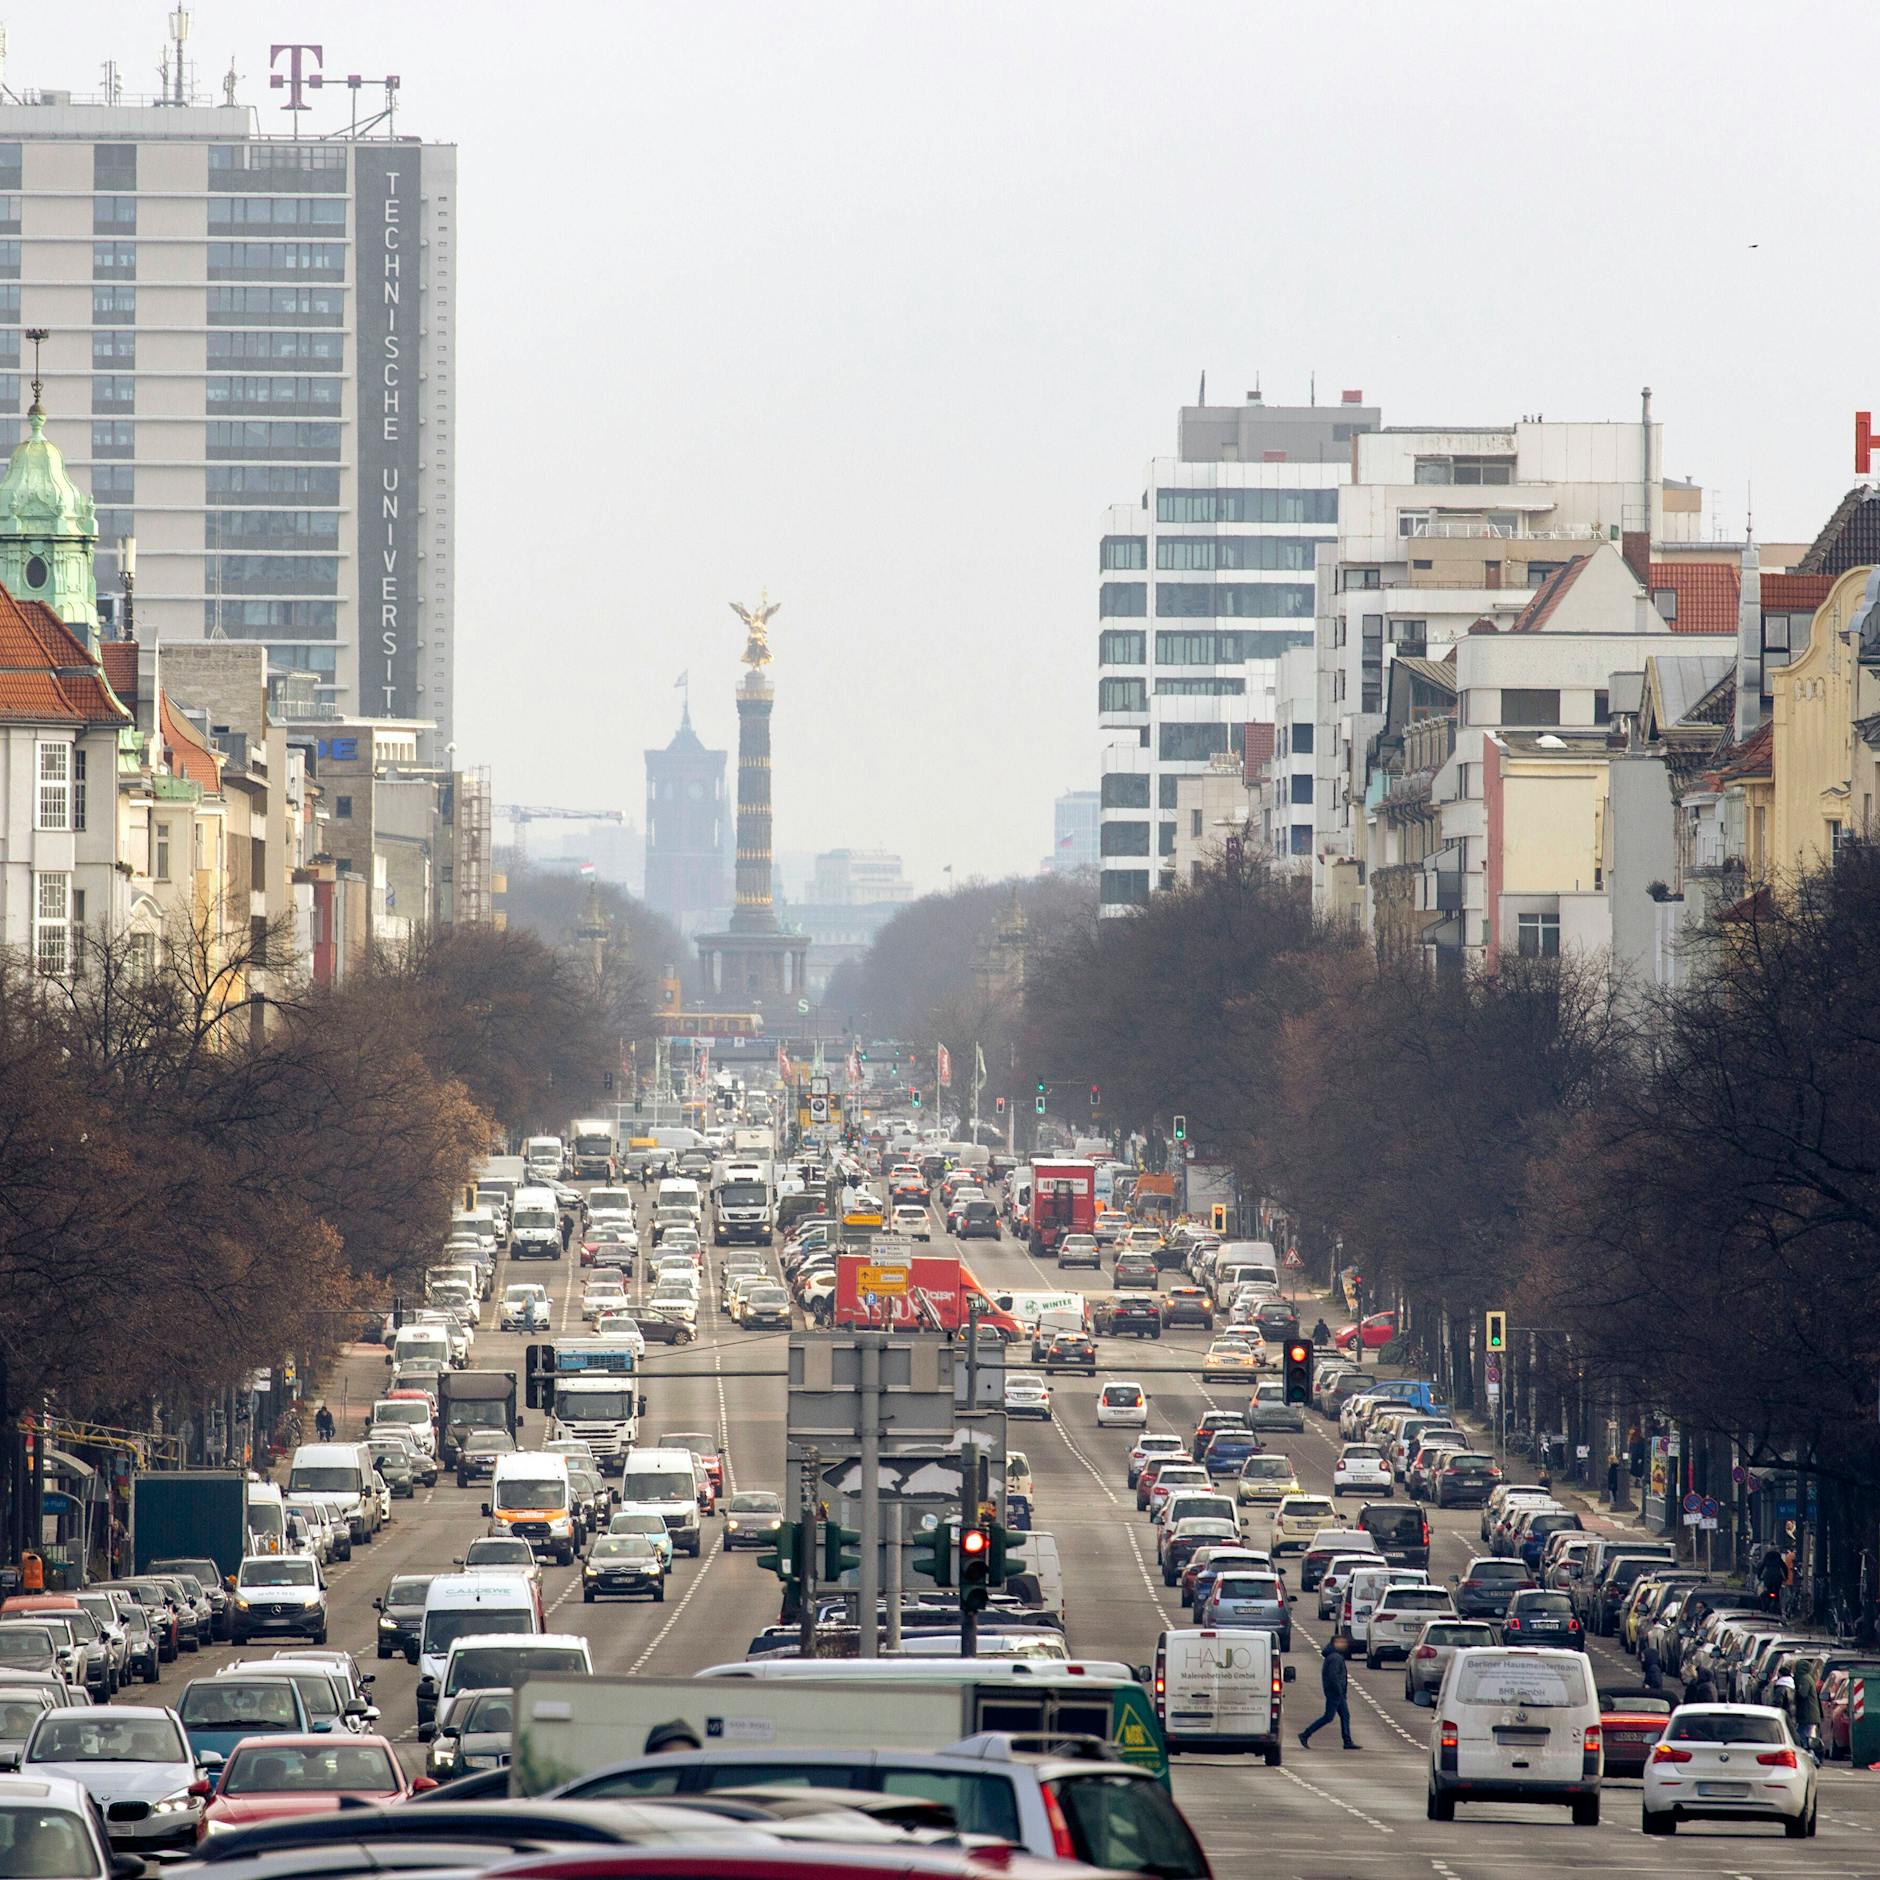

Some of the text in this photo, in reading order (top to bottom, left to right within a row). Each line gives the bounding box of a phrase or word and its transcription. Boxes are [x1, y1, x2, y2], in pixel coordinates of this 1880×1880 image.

[270, 45, 323, 110] T
[381, 172, 400, 718] TECHNISCHE UNIVERSIT
[798, 998, 809, 1013] S
[1042, 1298, 1072, 1310] WINTER
[1185, 1647, 1252, 1670] HAJO
[1467, 1660, 1579, 1672] Berliner Hausmeisterteam
[1518, 1687, 1545, 1696] GmbH
